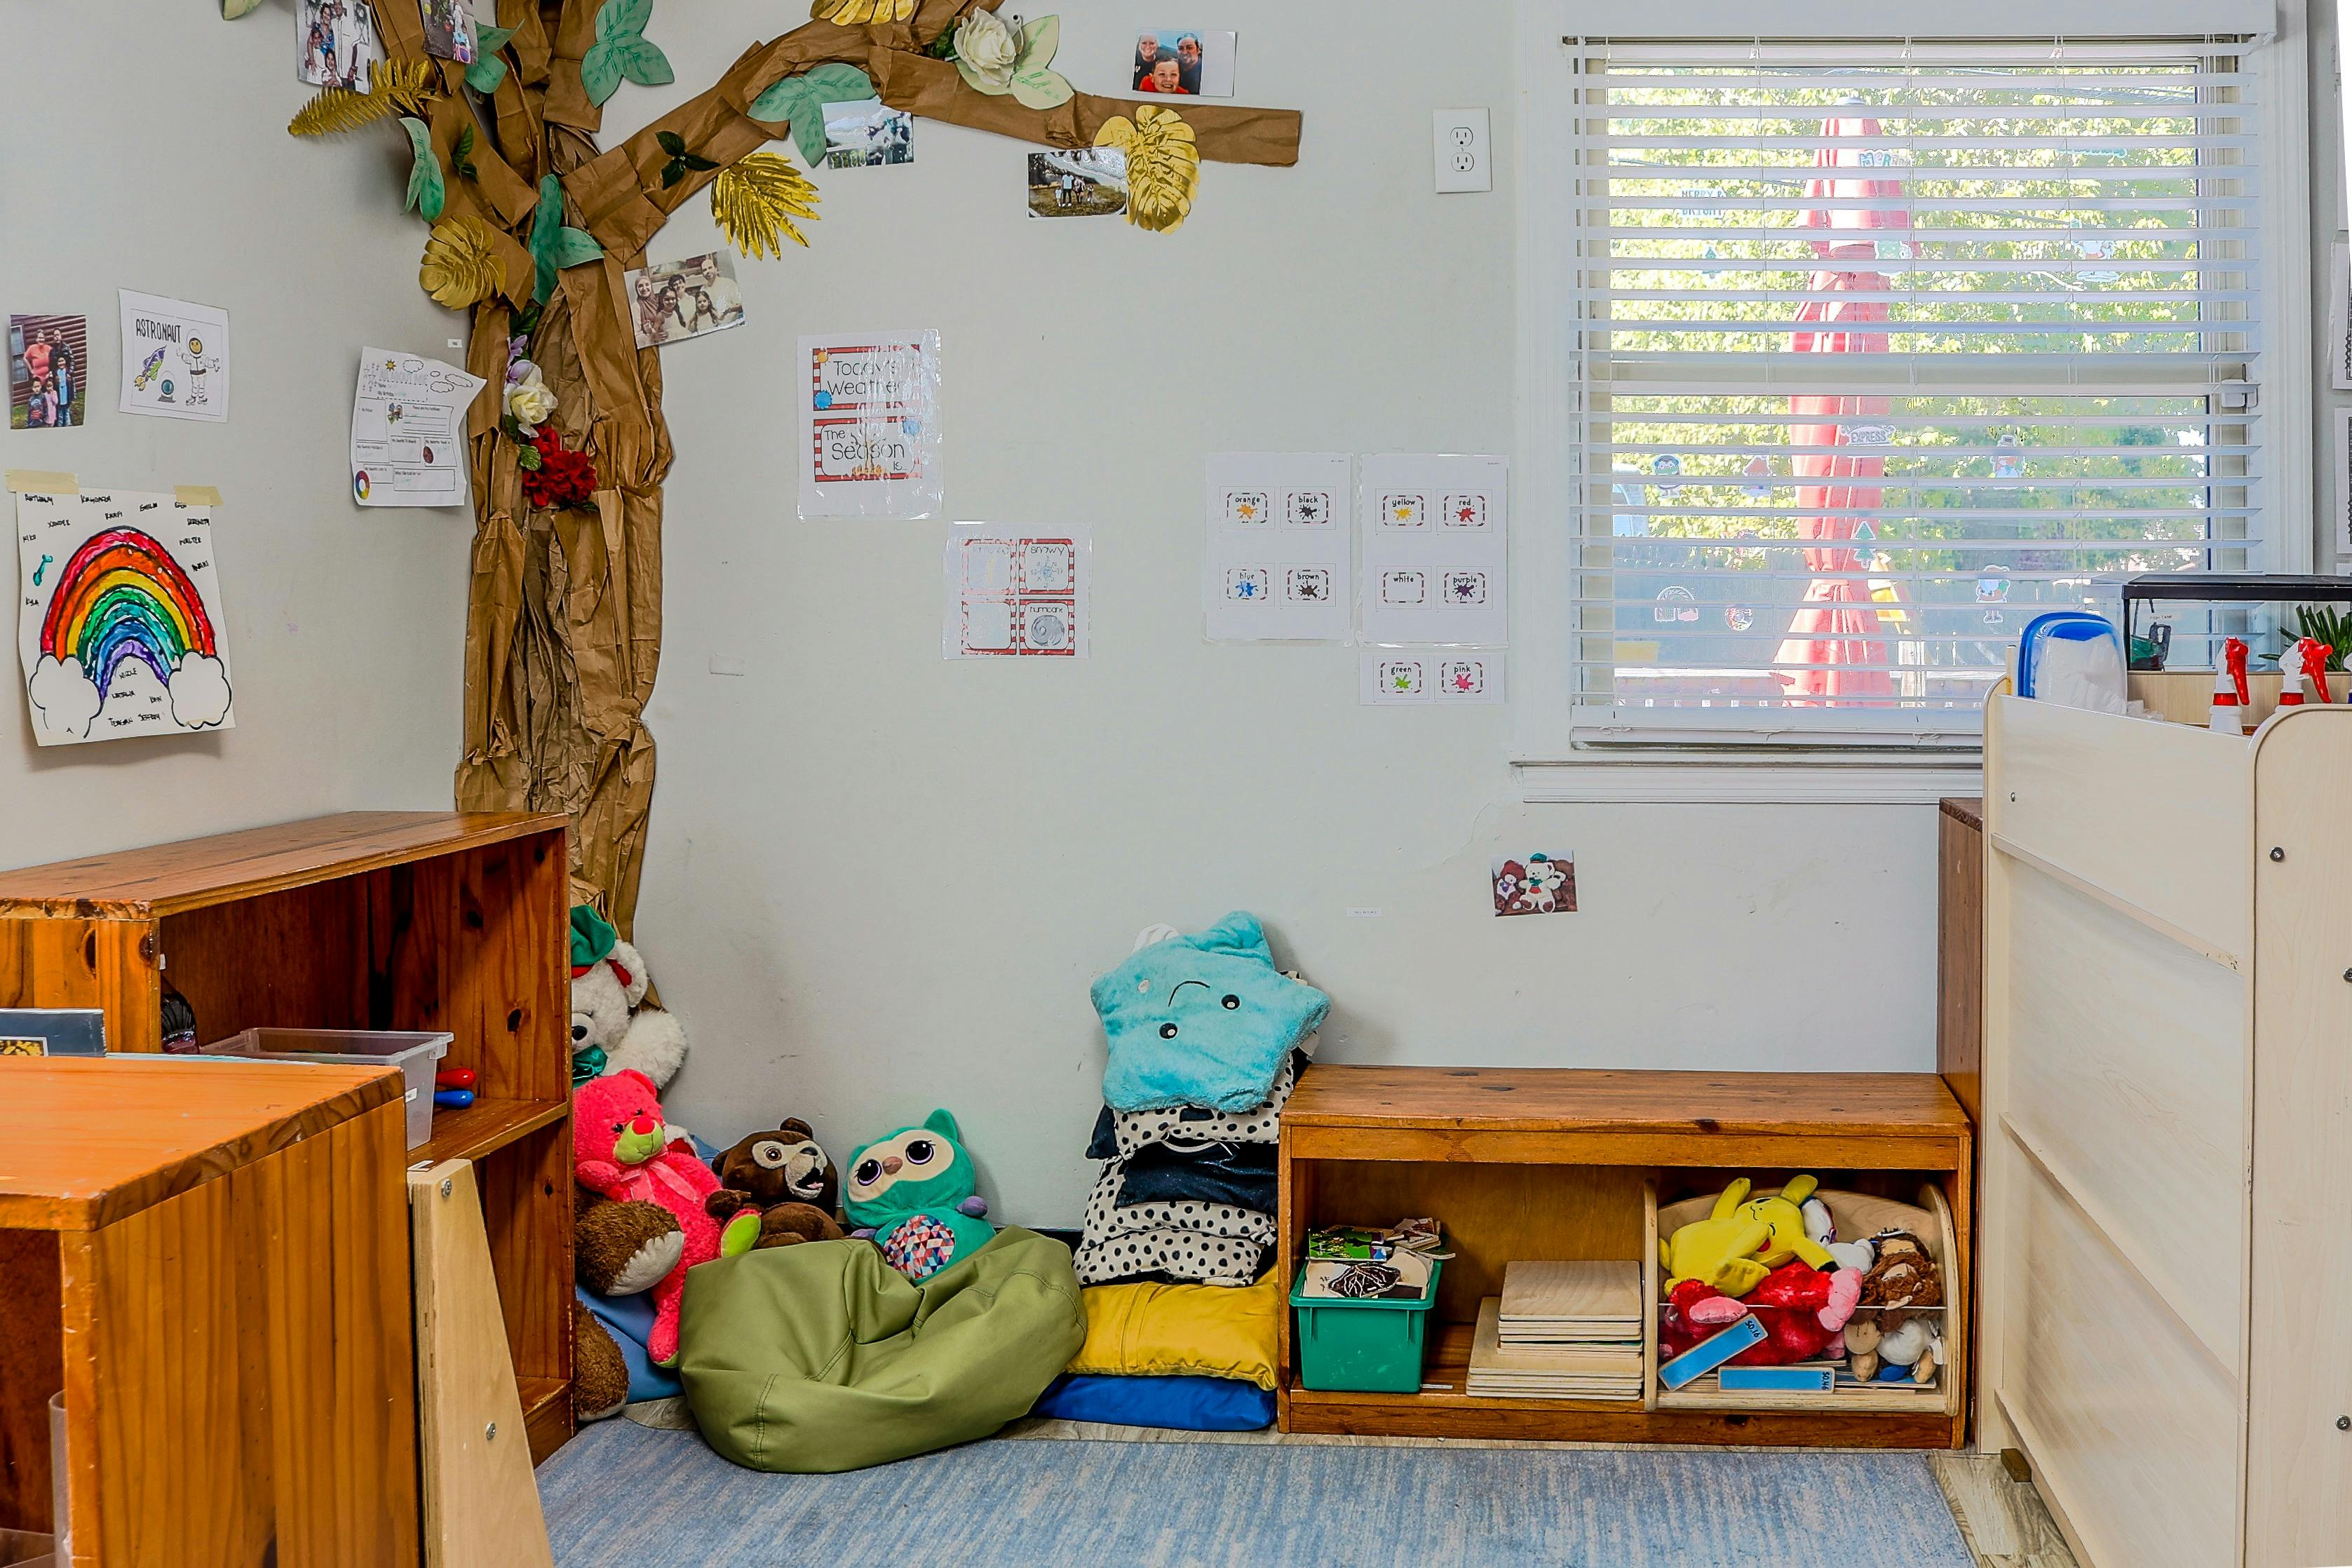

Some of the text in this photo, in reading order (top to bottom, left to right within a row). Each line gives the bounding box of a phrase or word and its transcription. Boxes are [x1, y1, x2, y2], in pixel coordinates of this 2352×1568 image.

[135, 318, 182, 344] ASTRONAUT
[824, 430, 846, 440] The
[1851, 431, 1886, 443] EXPRESS
[832, 442, 905, 460] Season
[1235, 496, 1260, 506] orange
[1392, 499, 1415, 507] yellow
[1030, 546, 1065, 555] snowy
[1393, 574, 1414, 582] white
[1453, 576, 1477, 586] purple
[1391, 667, 1412, 675] green
[1454, 665, 1471, 675] pink
